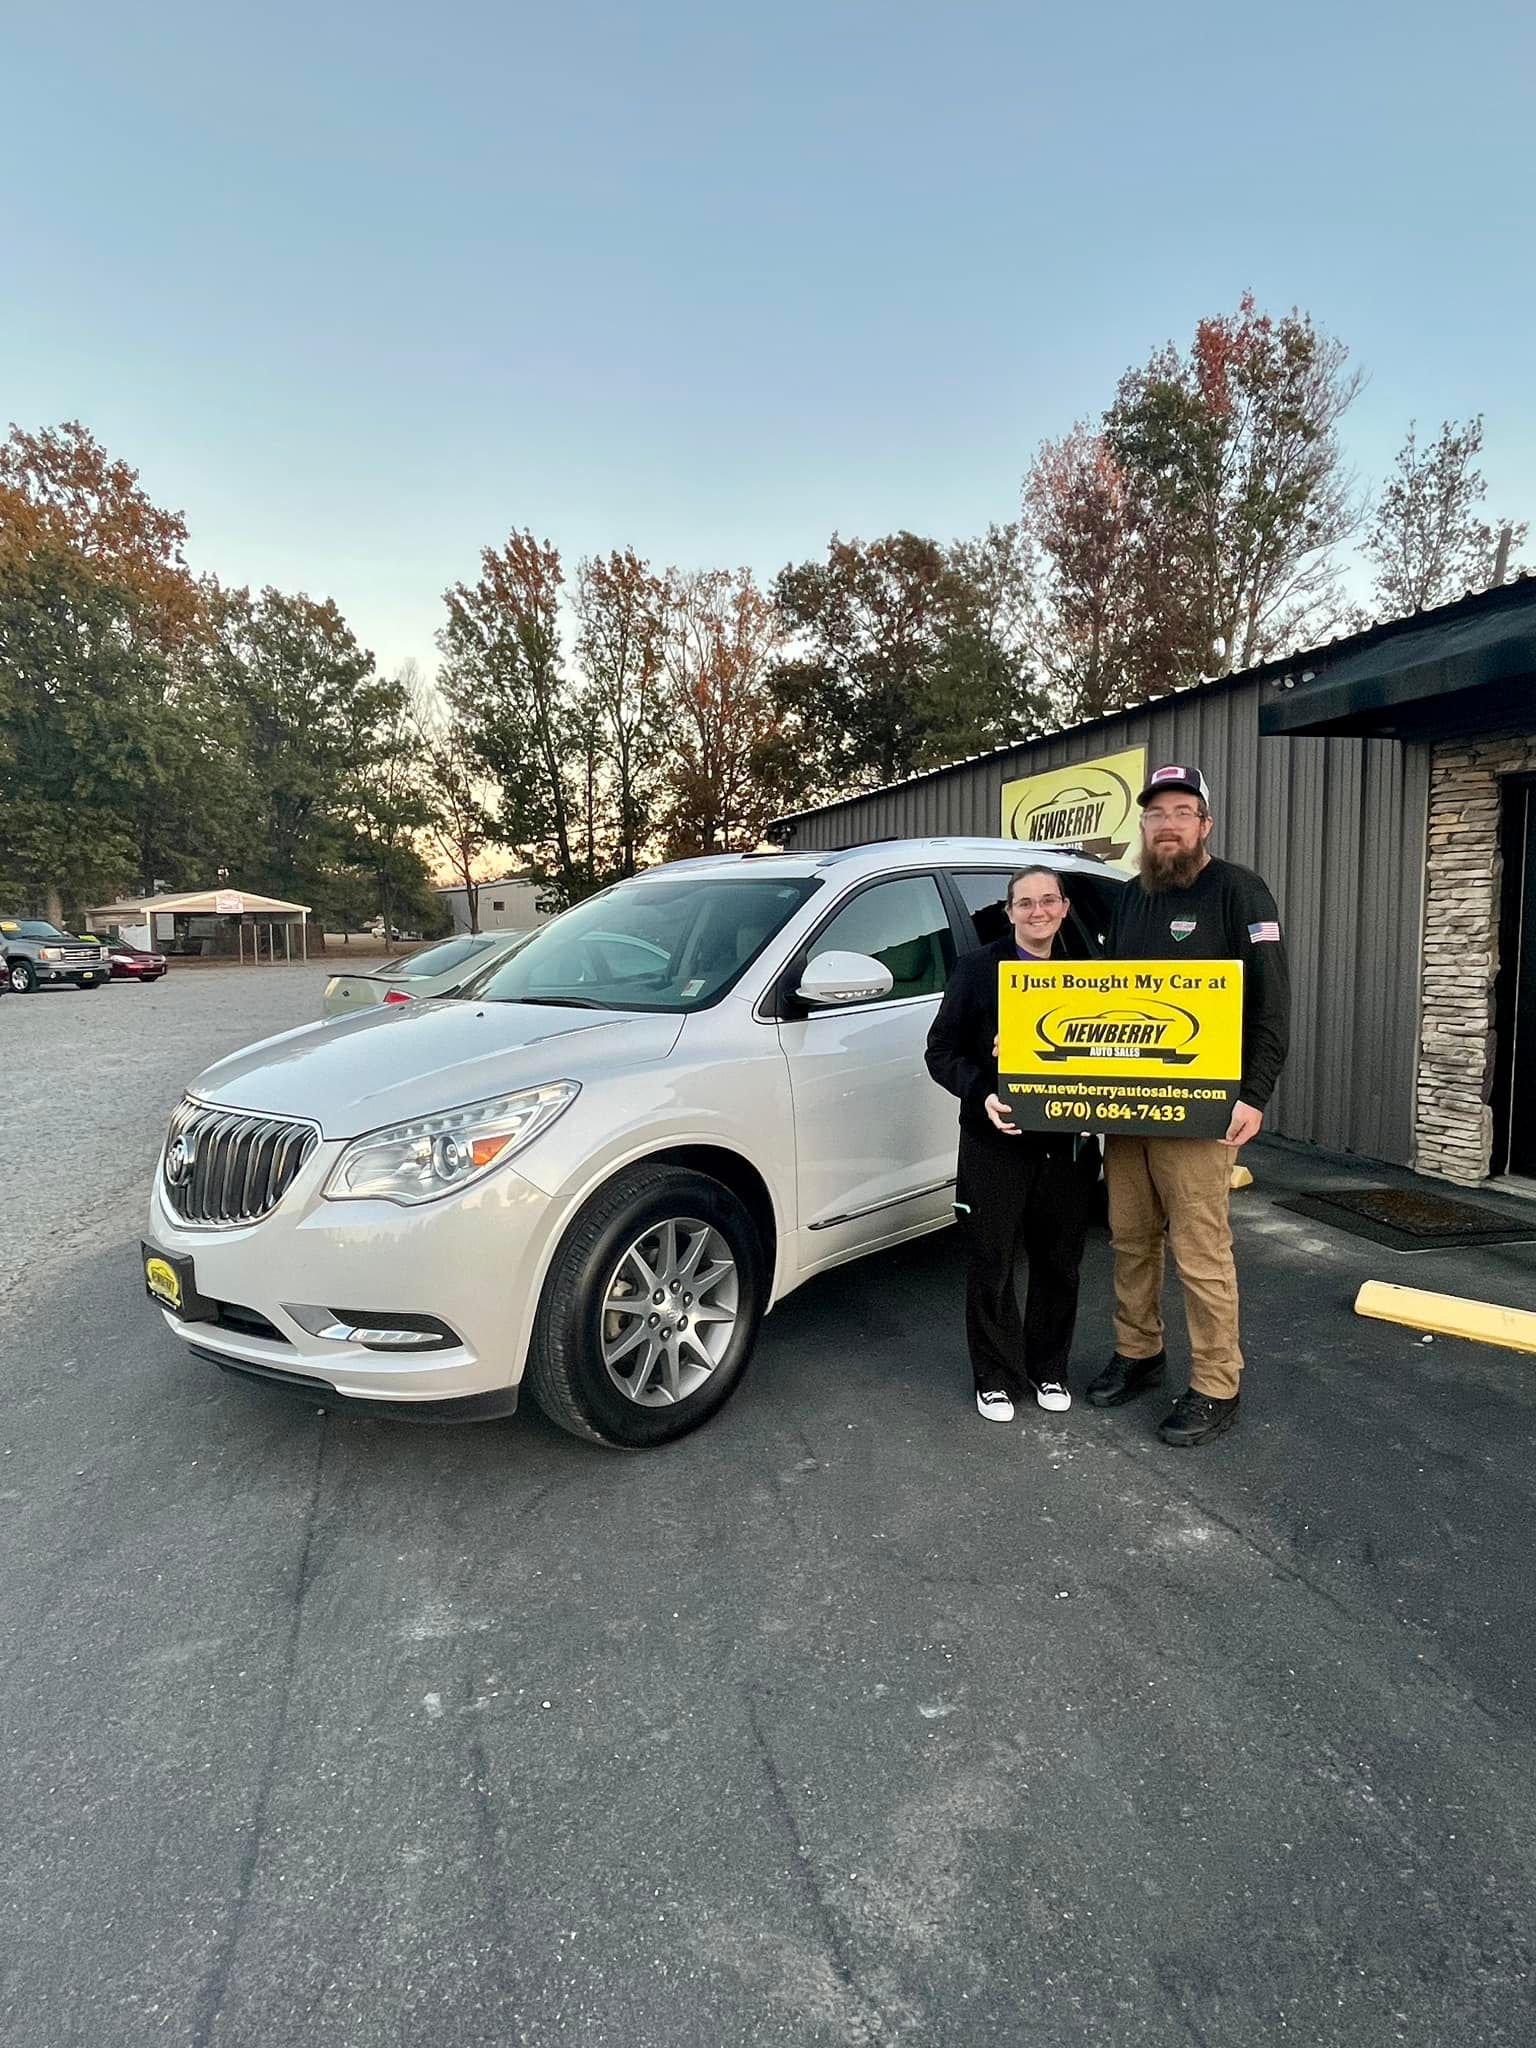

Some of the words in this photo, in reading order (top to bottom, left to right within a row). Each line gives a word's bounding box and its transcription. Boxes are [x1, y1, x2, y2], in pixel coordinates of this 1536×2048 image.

[1029, 801, 1105, 842] NEWBERRY
[1010, 975, 1017, 988] I
[1022, 975, 1056, 991] Just
[1062, 975, 1129, 992] Bought
[1134, 975, 1163, 993] My
[1169, 975, 1202, 989] Car
[1208, 976, 1227, 989] at
[1063, 1023, 1168, 1044] NEWBERRY
[1089, 1047, 1113, 1057] AUTO
[1114, 1047, 1140, 1057] SALES
[1007, 1082, 1227, 1100] www.newberryautosales.com
[1045, 1100, 1091, 1120] (870)
[1096, 1103, 1186, 1121] 684-7433
